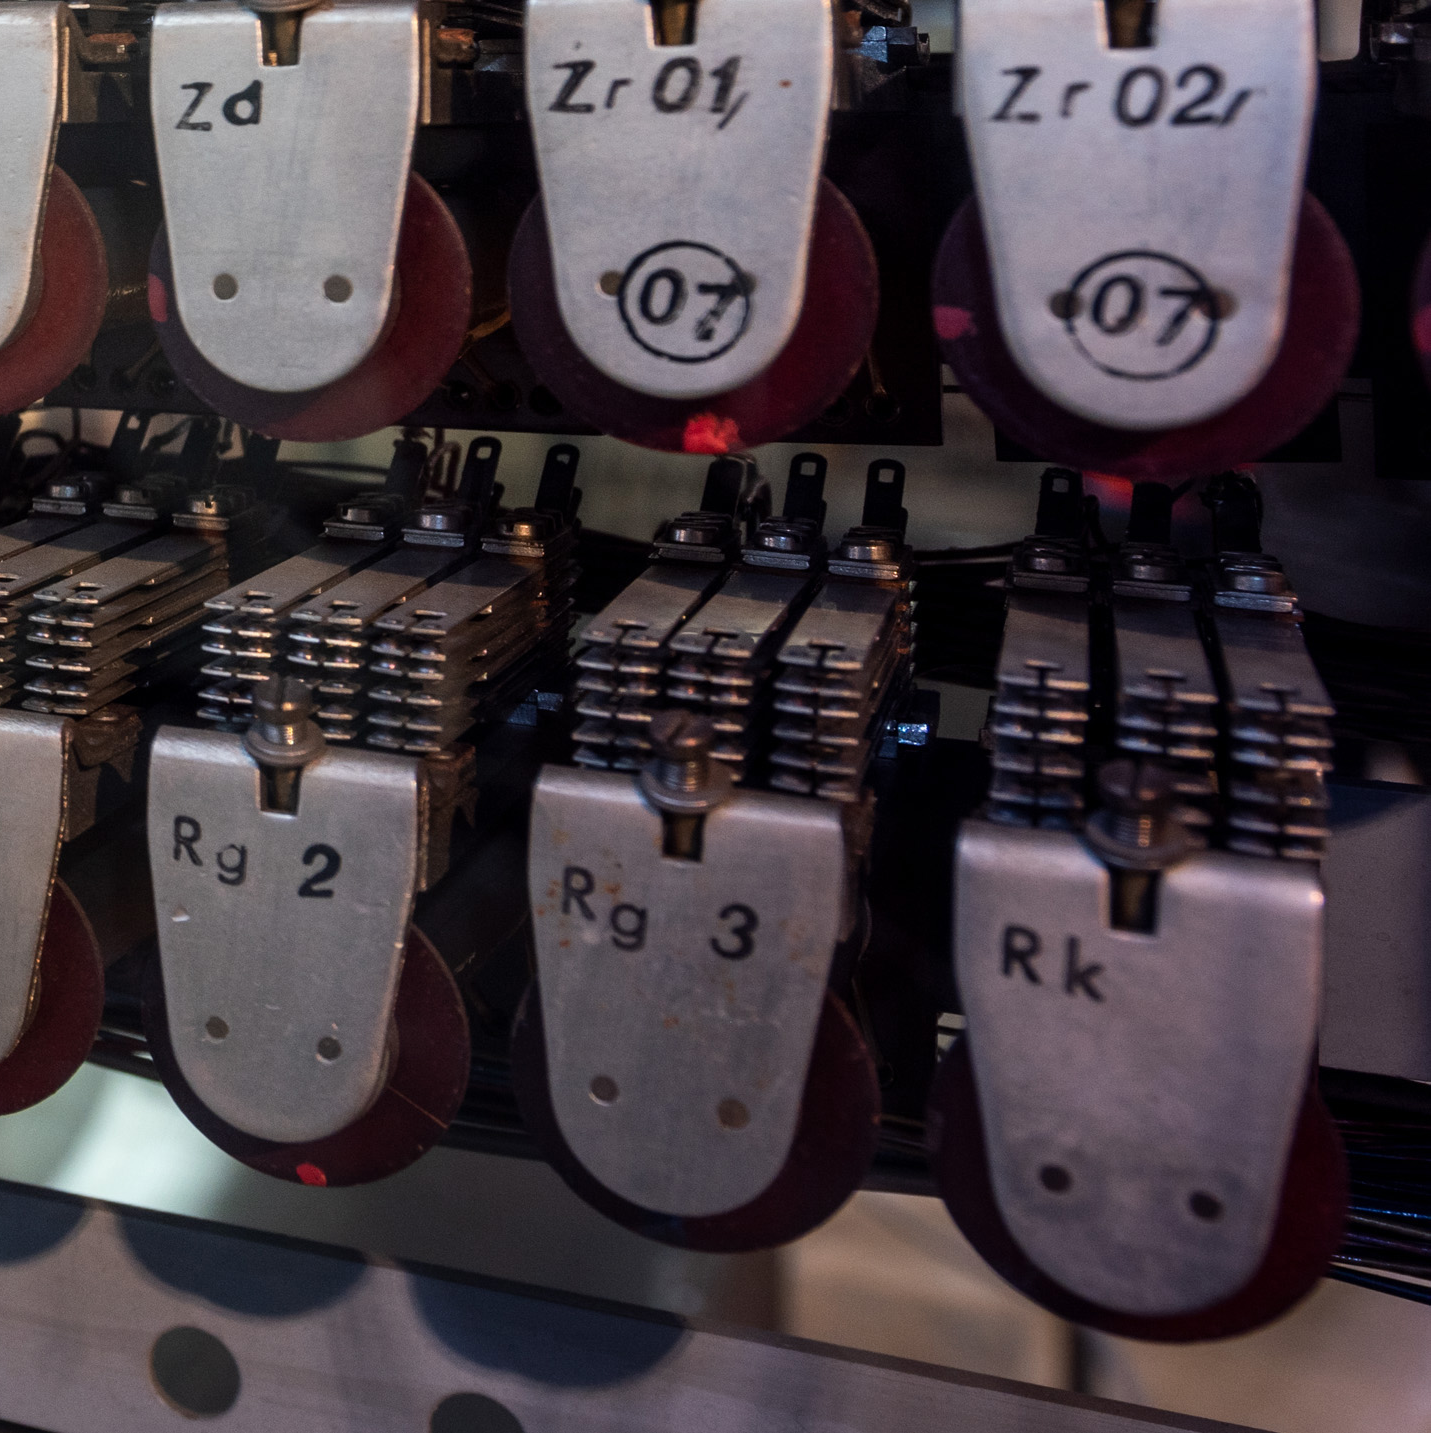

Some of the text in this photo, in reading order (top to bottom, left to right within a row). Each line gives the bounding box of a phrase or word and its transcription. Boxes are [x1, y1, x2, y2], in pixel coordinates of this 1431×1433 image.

[174, 79, 264, 132] Zd
[637, 265, 741, 343] 07
[1089, 272, 1209, 349] 07
[172, 814, 343, 899] Rg 2
[559, 865, 760, 962] Rg 3
[1000, 924, 1107, 1004] Rk
